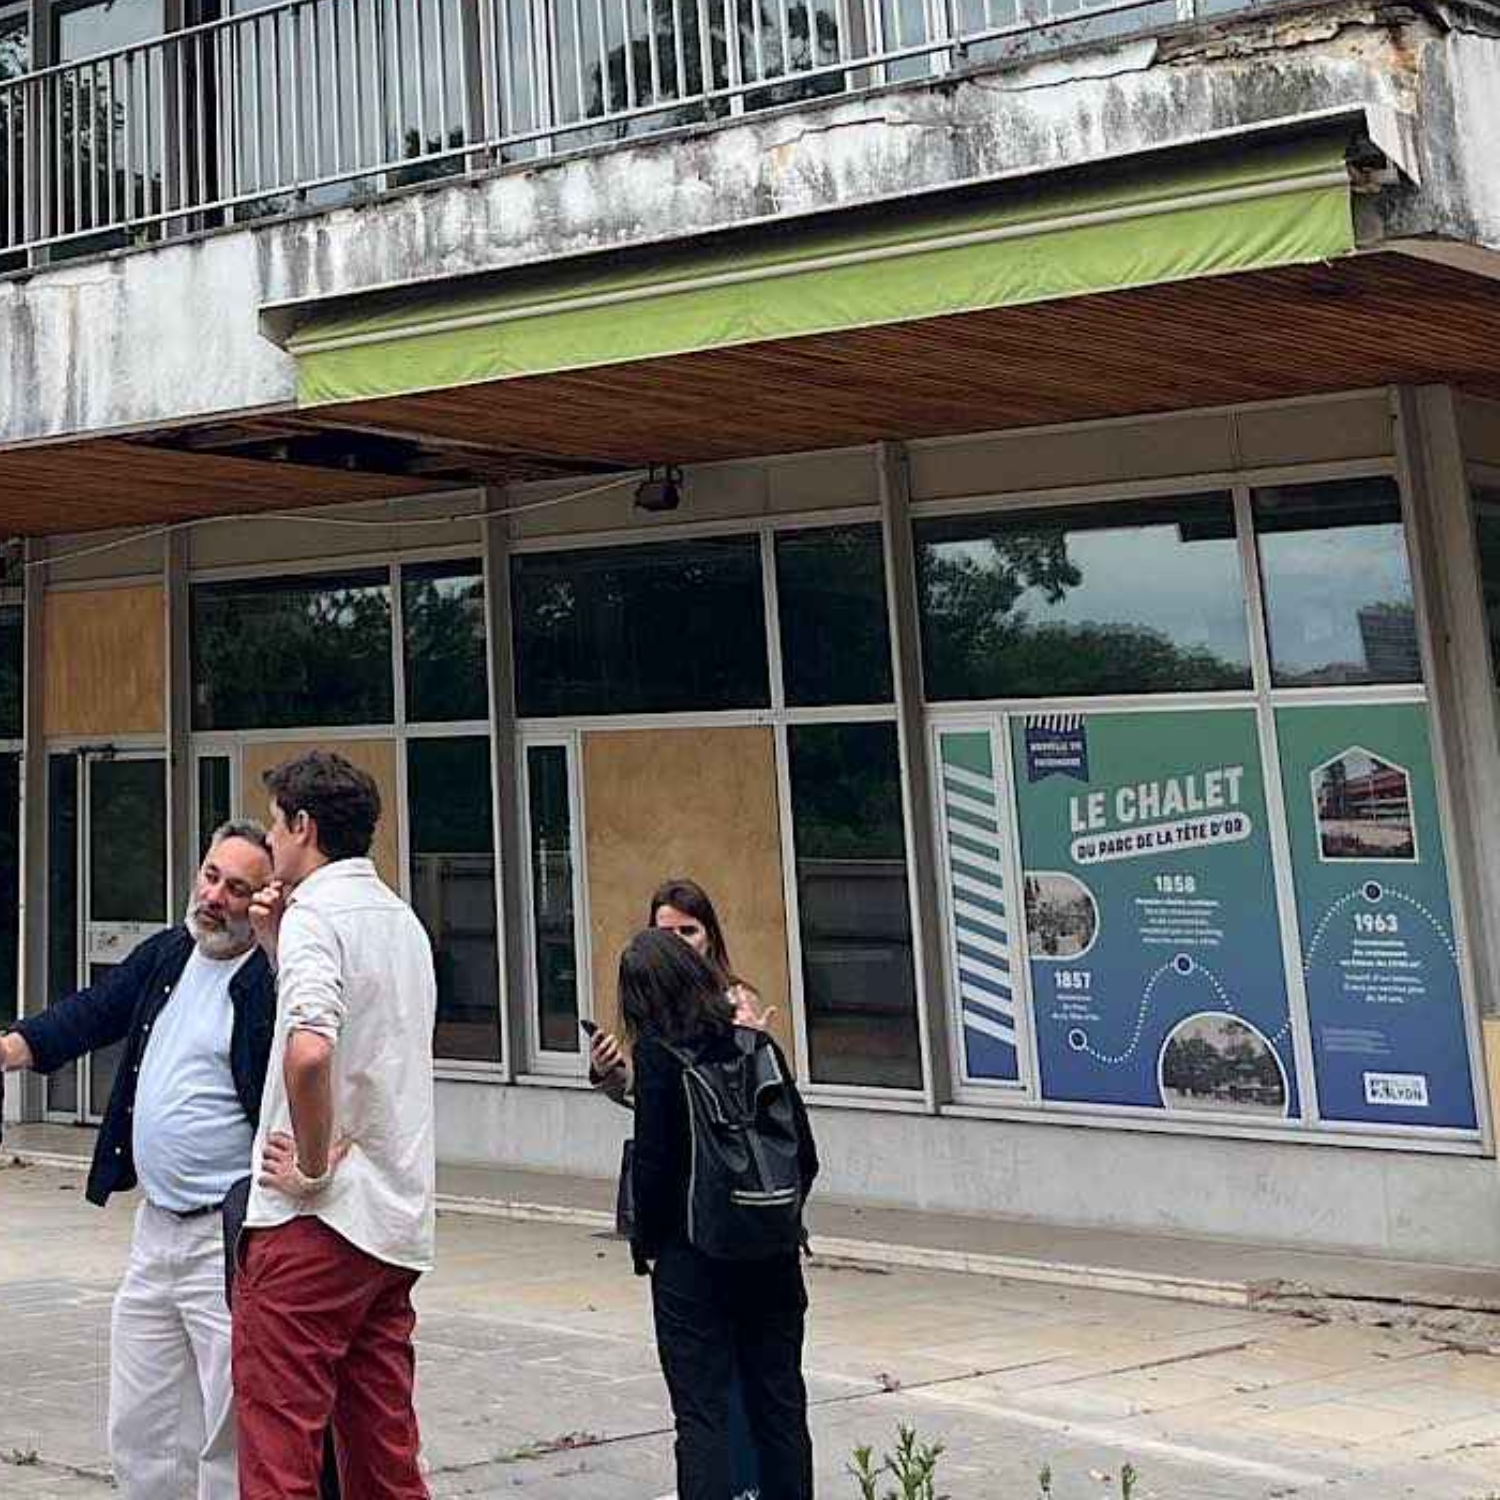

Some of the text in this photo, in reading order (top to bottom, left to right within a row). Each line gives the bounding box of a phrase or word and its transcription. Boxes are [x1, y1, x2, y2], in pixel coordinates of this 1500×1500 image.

[1069, 766, 1243, 832] LE CHALET
[1077, 818, 1243, 859] DU PARC DE LA TÊTE D'OR
[1155, 875, 1196, 893] 1858
[1354, 913, 1398, 932] 1963
[1054, 971, 1090, 989] 1857
